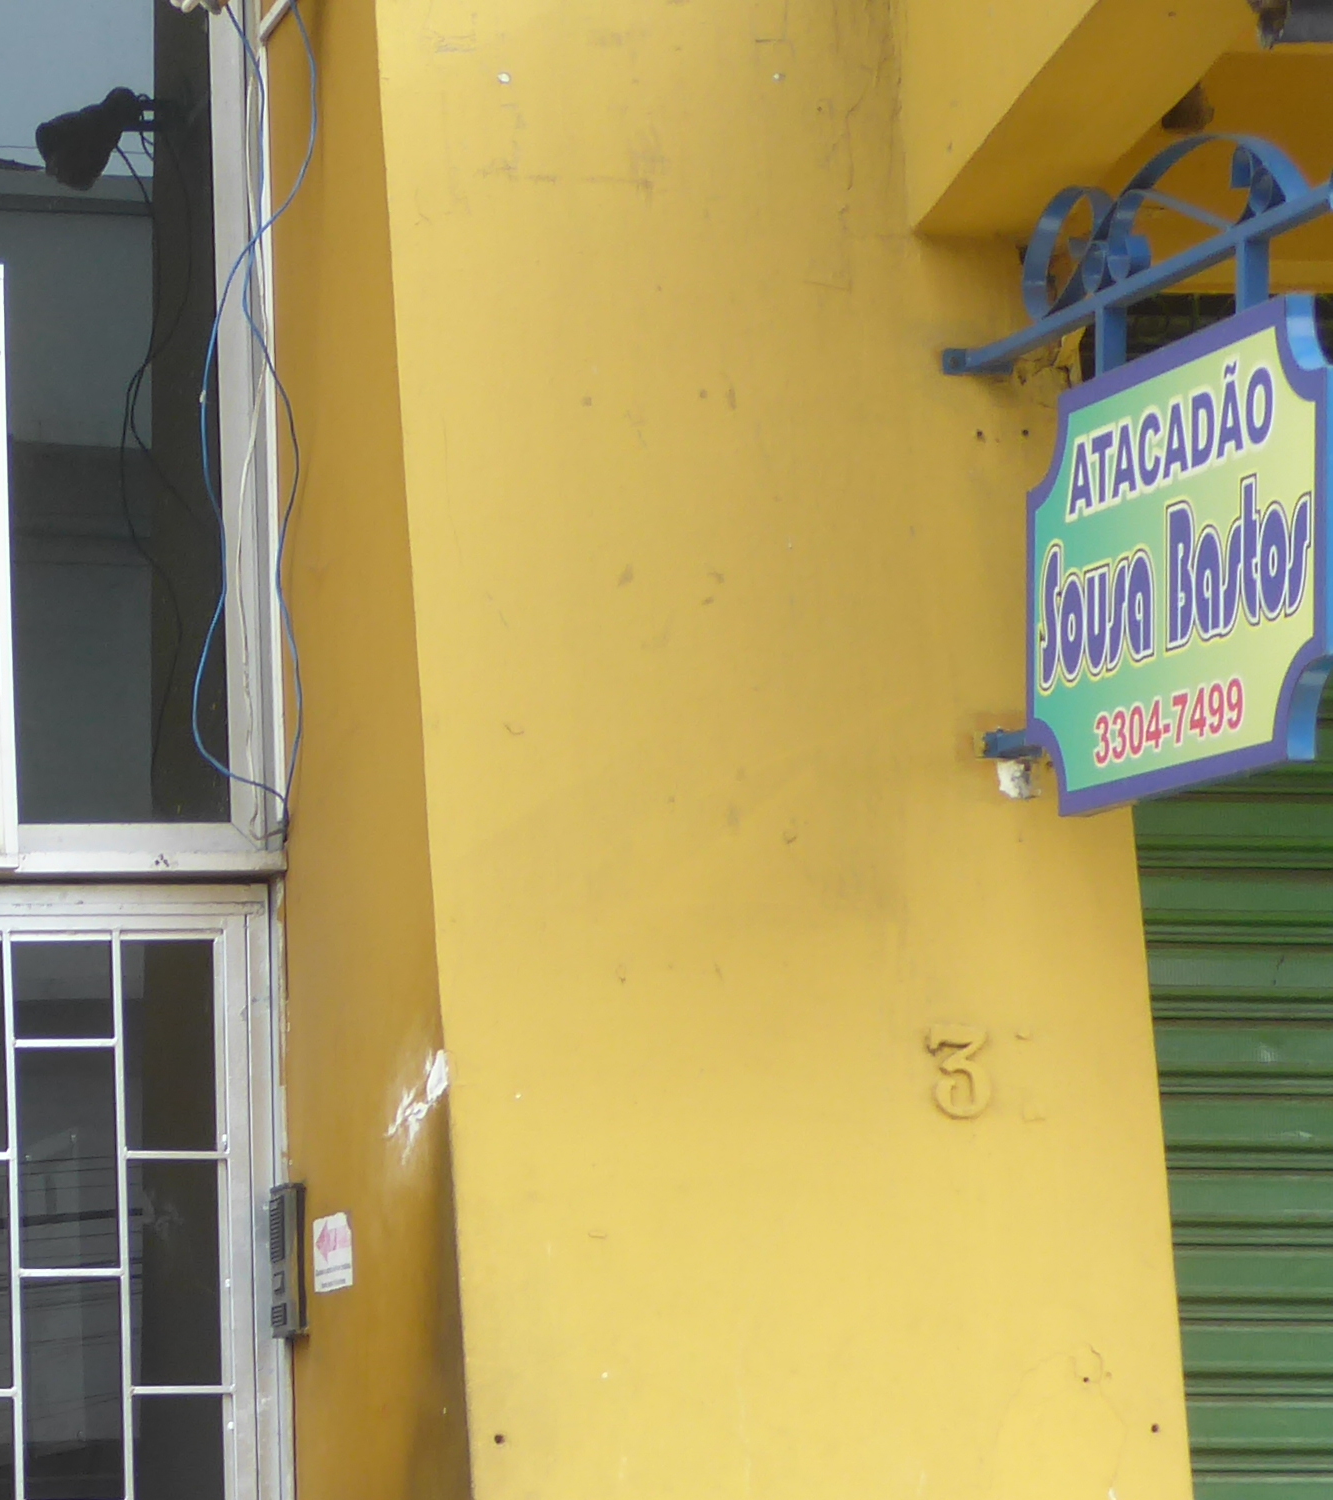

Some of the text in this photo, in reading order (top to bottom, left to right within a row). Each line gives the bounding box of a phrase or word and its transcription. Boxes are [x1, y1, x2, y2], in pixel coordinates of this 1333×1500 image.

[1068, 361, 1275, 517] ATACADÃO
[1039, 473, 1311, 692] Sousa Bastos
[1095, 678, 1244, 765] 3304-7499
